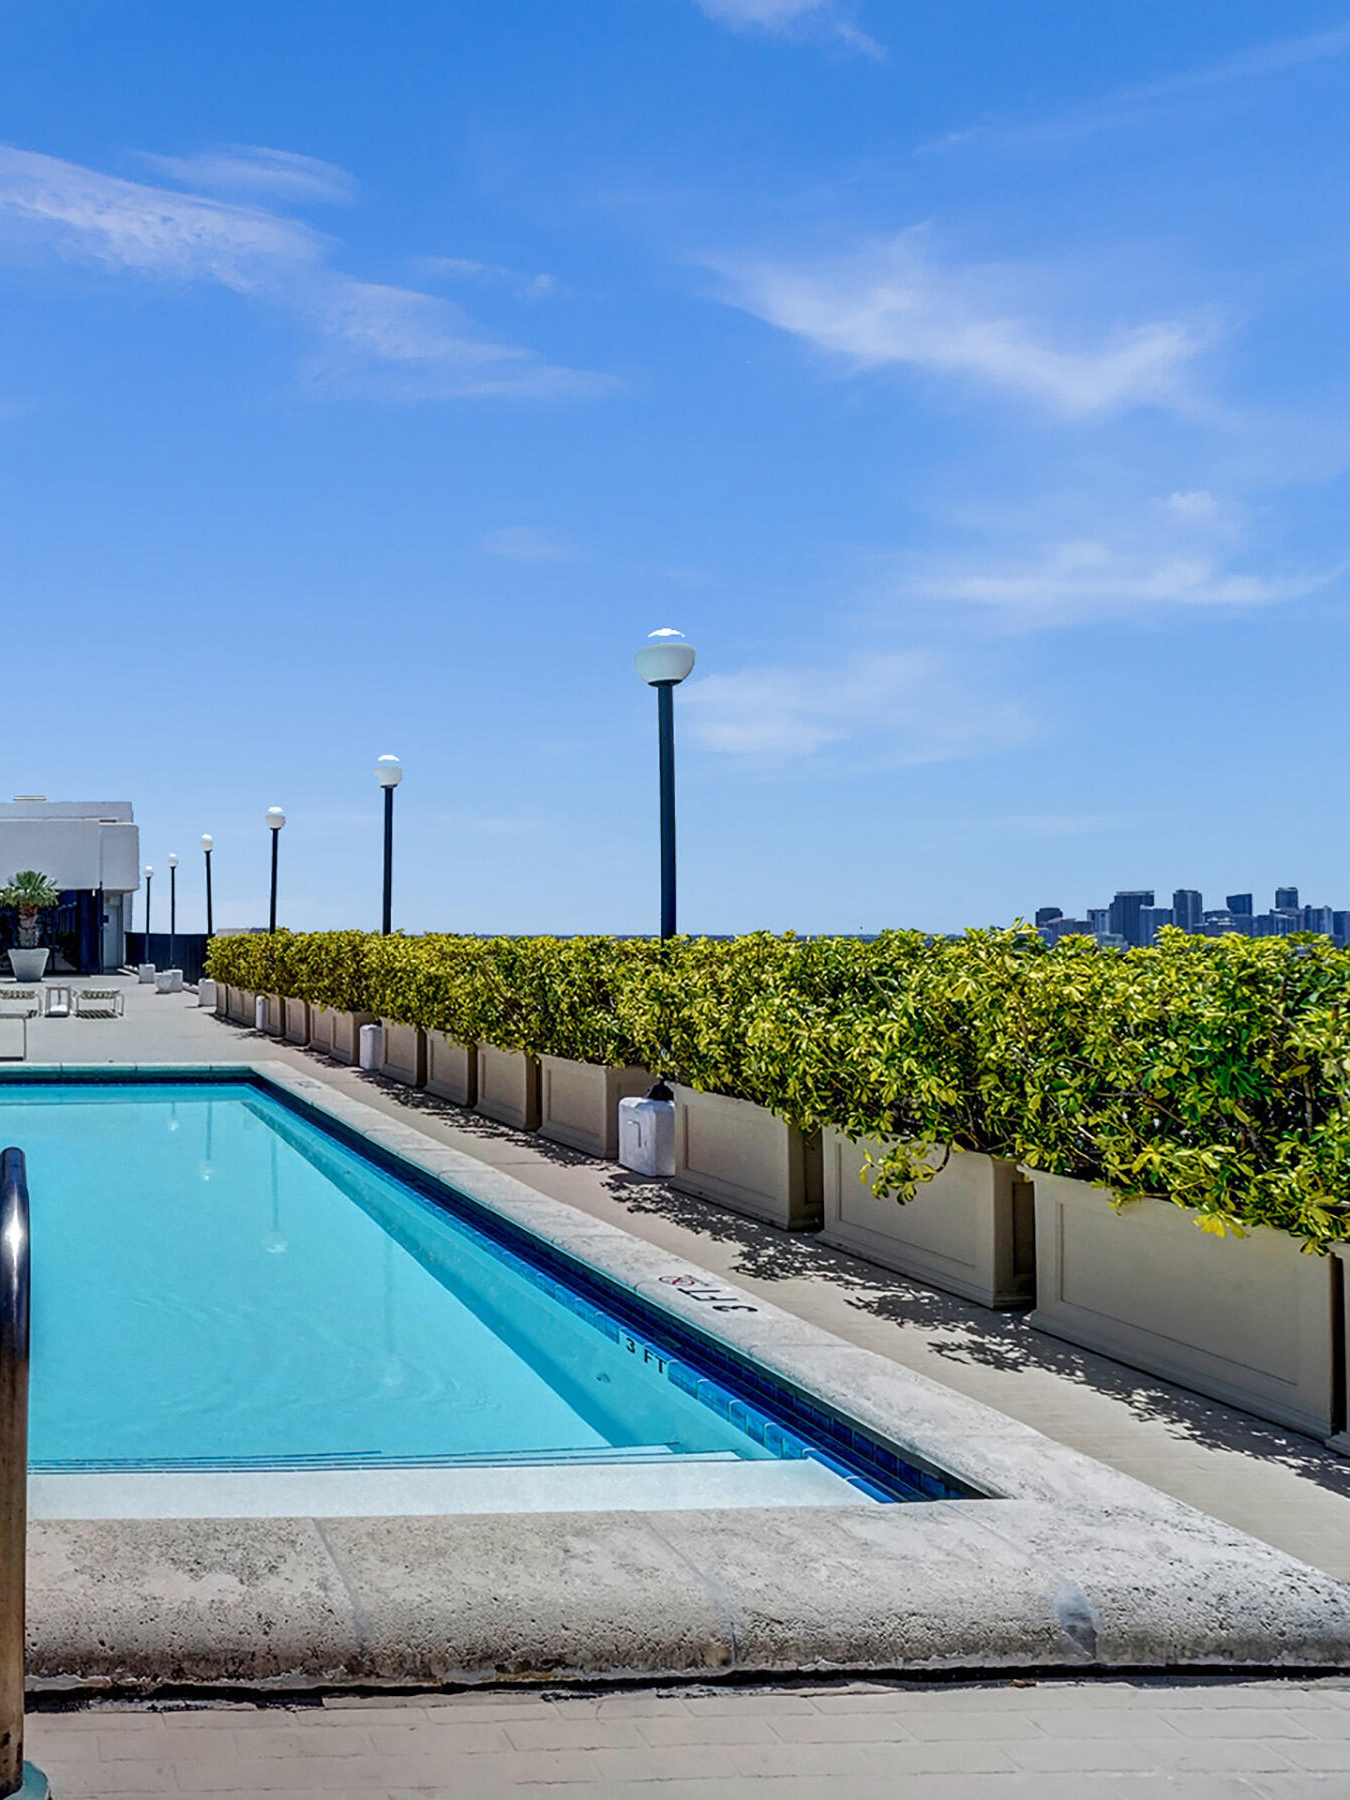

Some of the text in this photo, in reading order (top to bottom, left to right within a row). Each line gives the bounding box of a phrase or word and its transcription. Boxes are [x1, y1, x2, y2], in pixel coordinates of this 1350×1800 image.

[677, 1288, 739, 1302] FT
[625, 1336, 667, 1374] 3 FT
